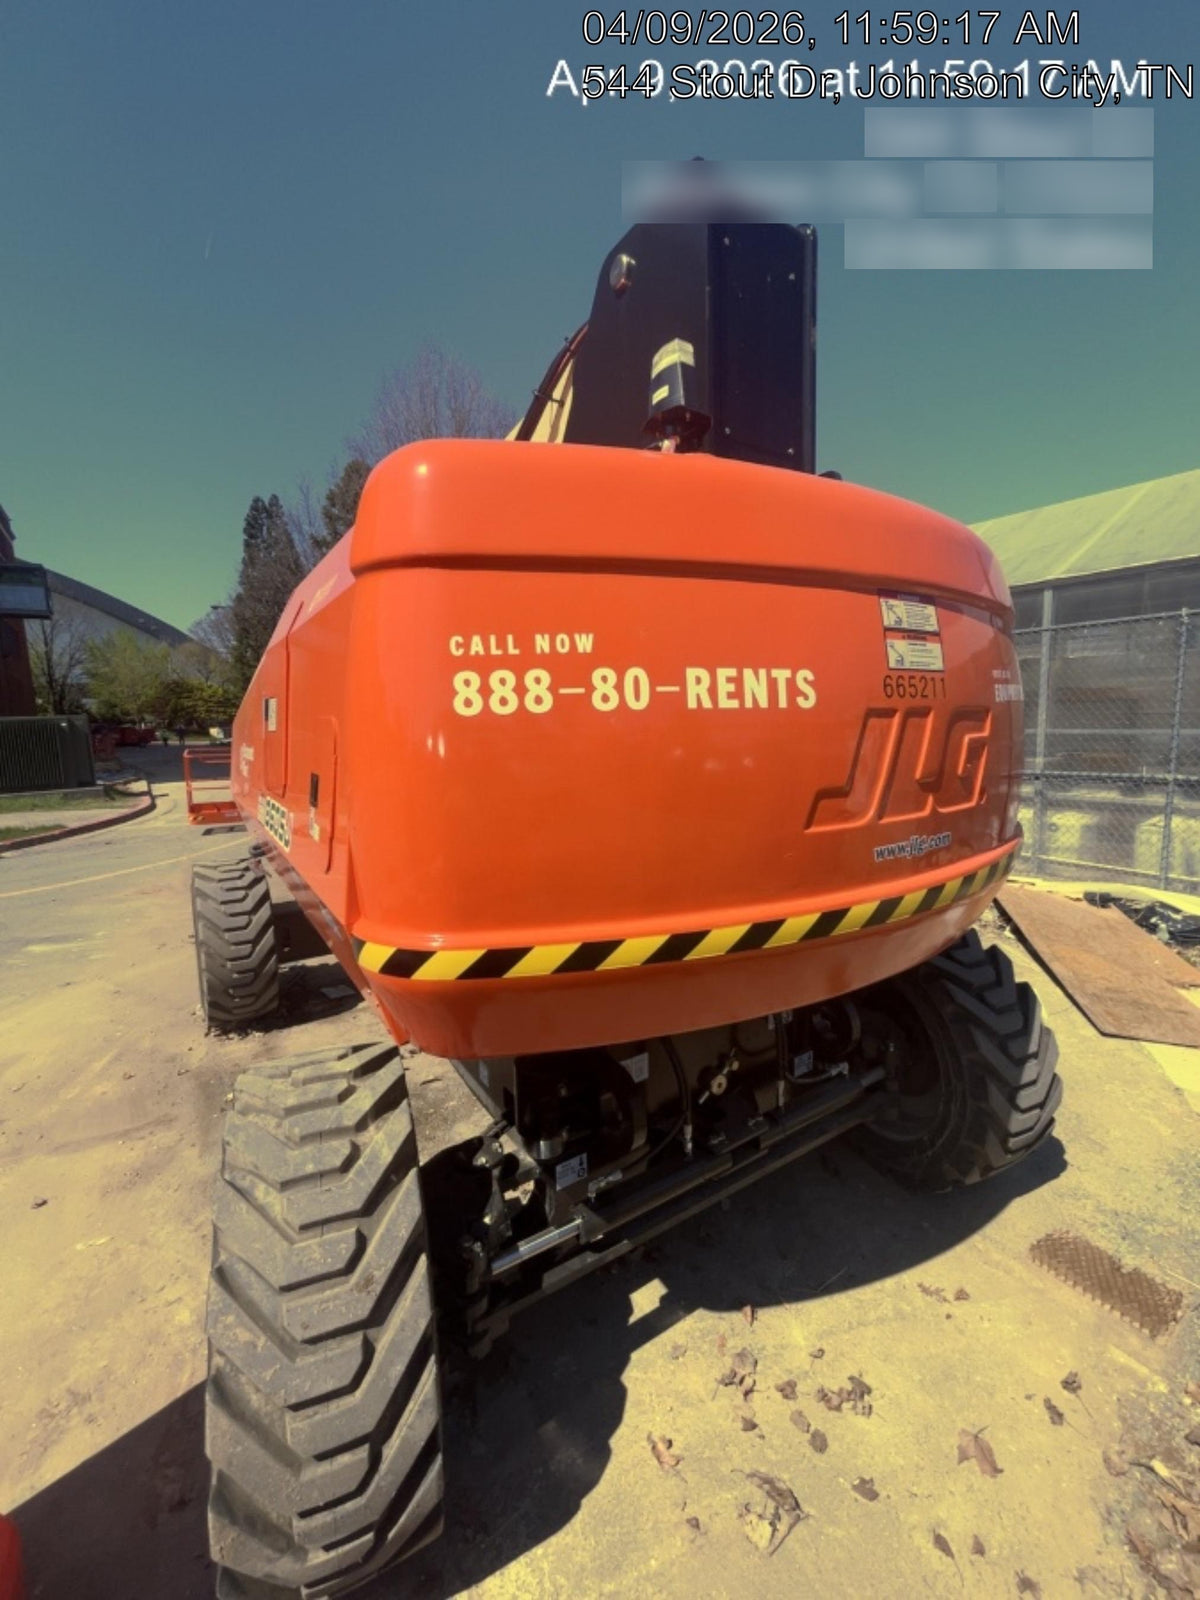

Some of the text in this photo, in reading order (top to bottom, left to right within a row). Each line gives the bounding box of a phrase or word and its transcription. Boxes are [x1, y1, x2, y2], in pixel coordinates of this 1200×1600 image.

[448, 632, 595, 657] CALL NOW
[452, 666, 818, 717] 888-80-RENTS
[882, 674, 948, 699] 665211
[803, 706, 993, 833] JLG
[873, 831, 954, 863] www.jlg.com
